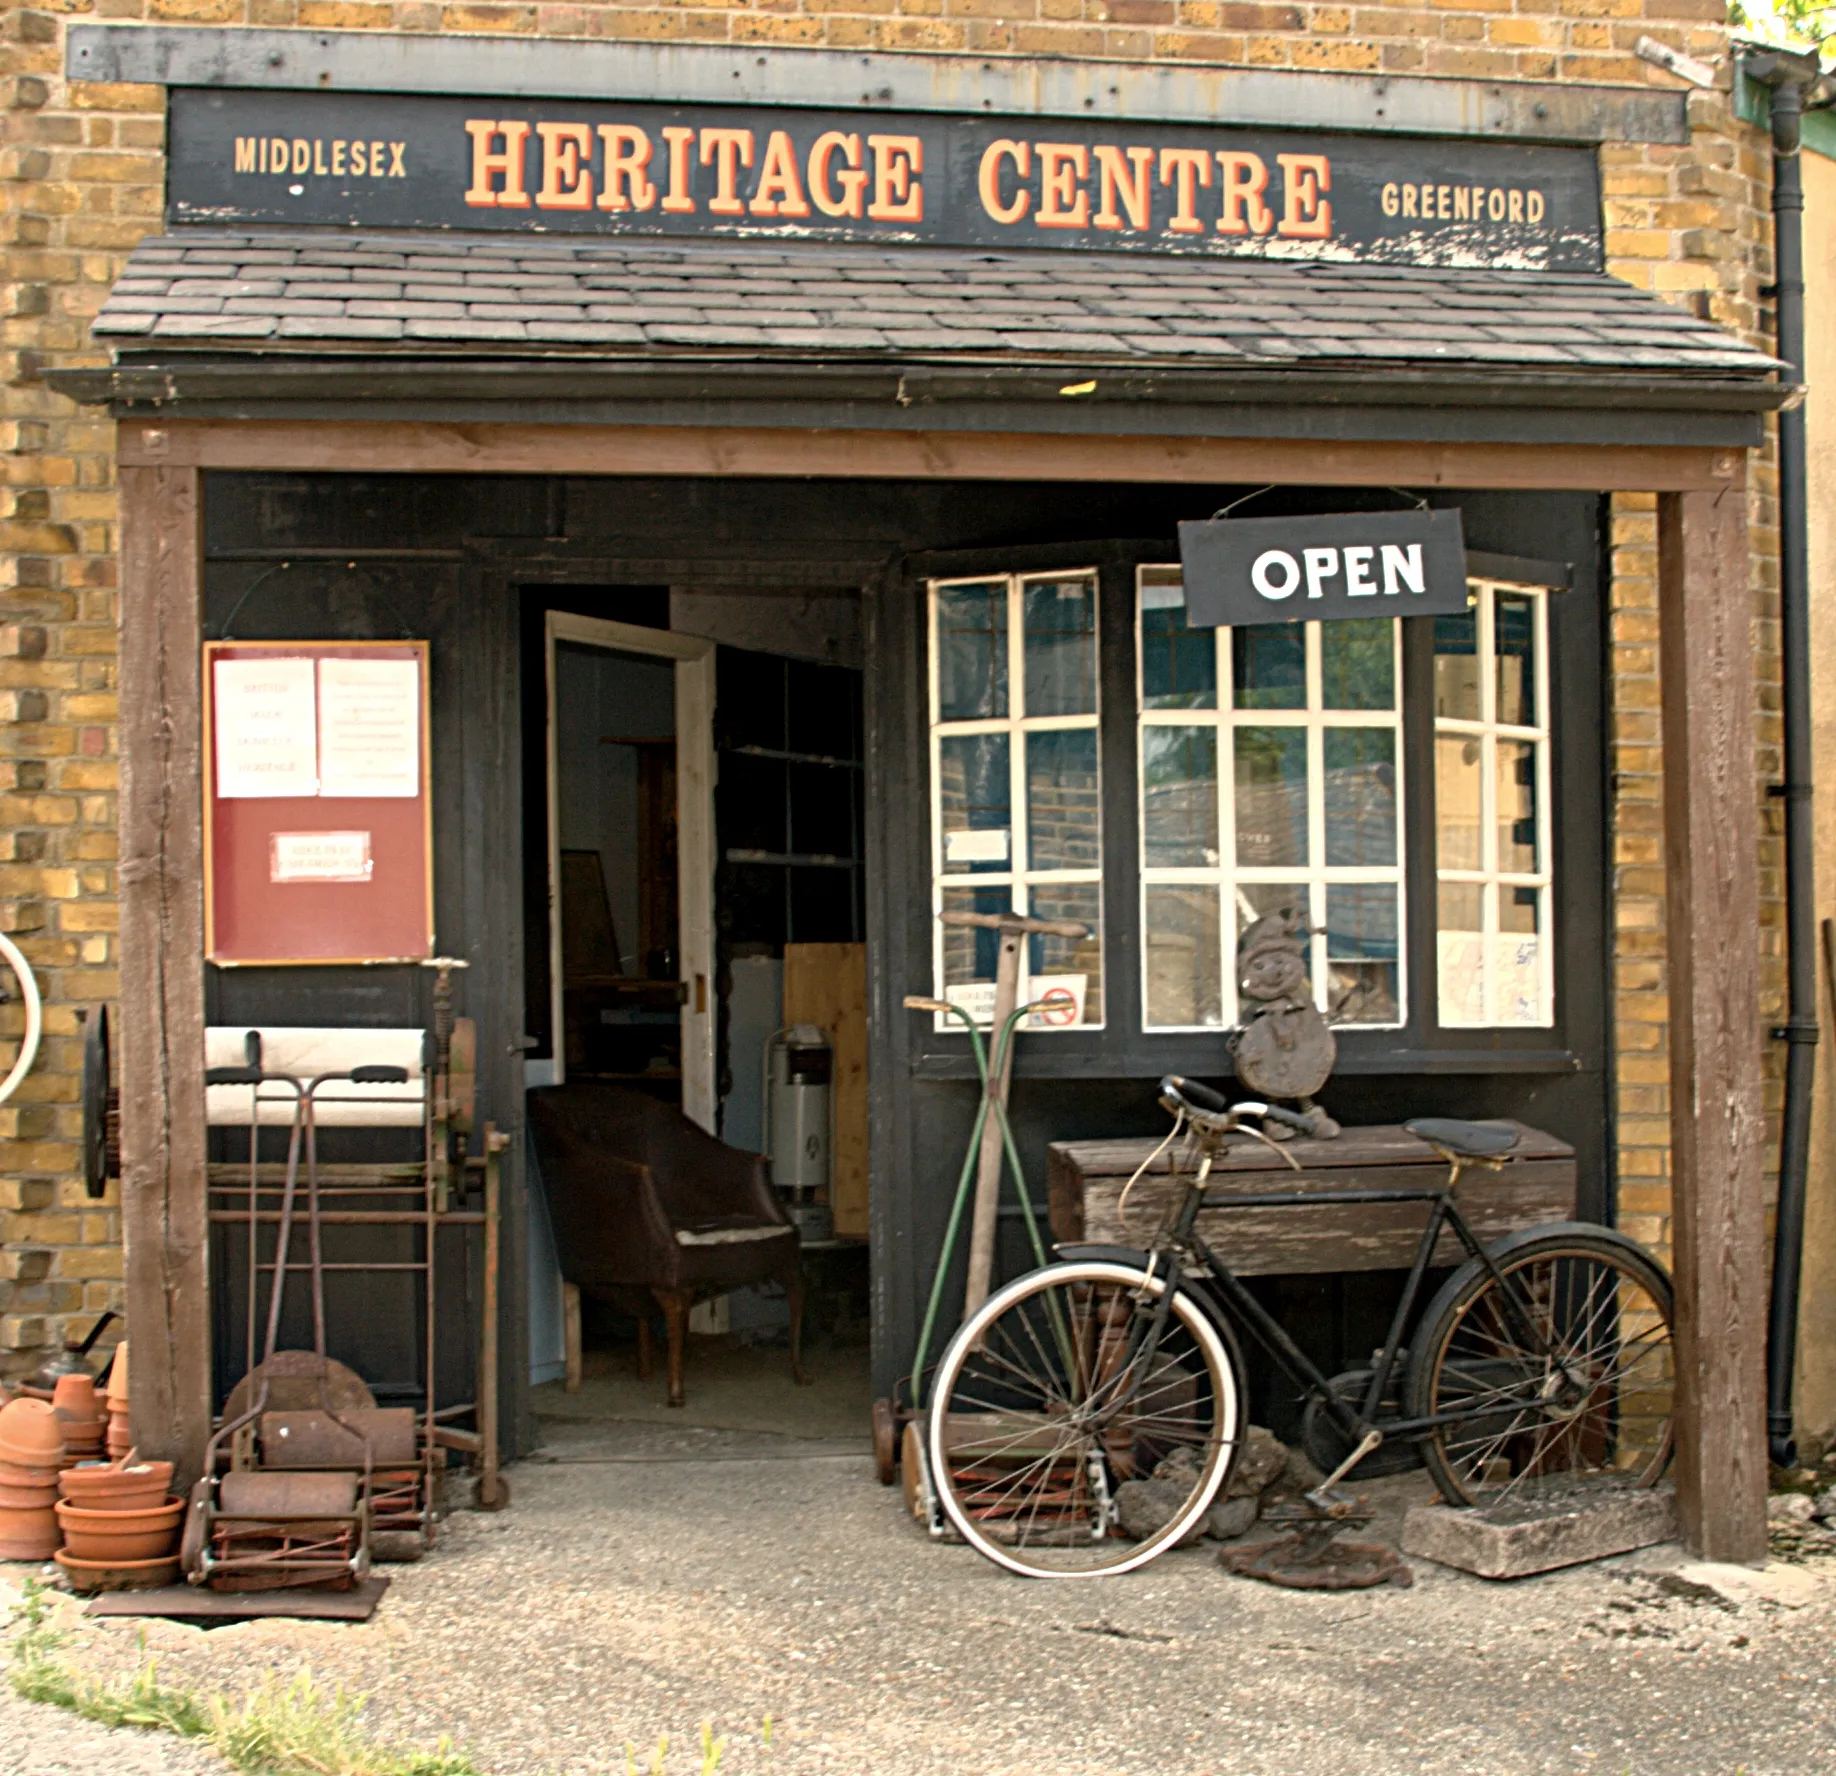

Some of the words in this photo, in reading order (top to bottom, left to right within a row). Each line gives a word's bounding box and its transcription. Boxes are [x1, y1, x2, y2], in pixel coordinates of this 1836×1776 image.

[234, 136, 407, 178] MIDDLESEX
[464, 119, 924, 223] HERITAGE
[978, 138, 1332, 239] CENTRE
[1381, 181, 1545, 225] GREENFORD
[1251, 543, 1426, 600] OPEN
